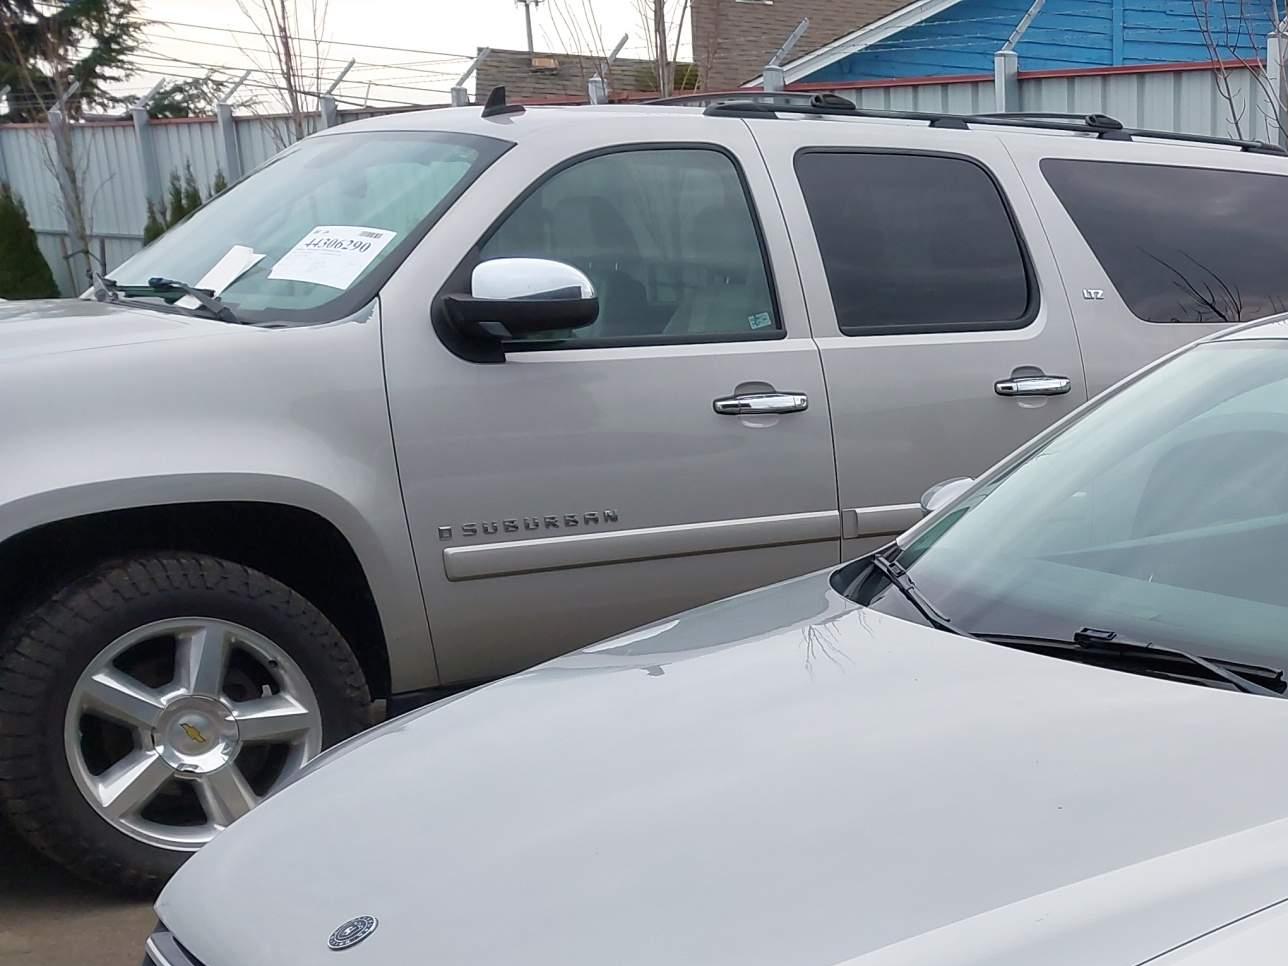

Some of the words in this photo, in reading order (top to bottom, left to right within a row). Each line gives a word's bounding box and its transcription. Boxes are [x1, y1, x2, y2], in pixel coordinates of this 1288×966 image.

[304, 238, 372, 253] 44306290
[1082, 288, 1105, 300] LTZ
[462, 508, 619, 537] SUBURBAN
